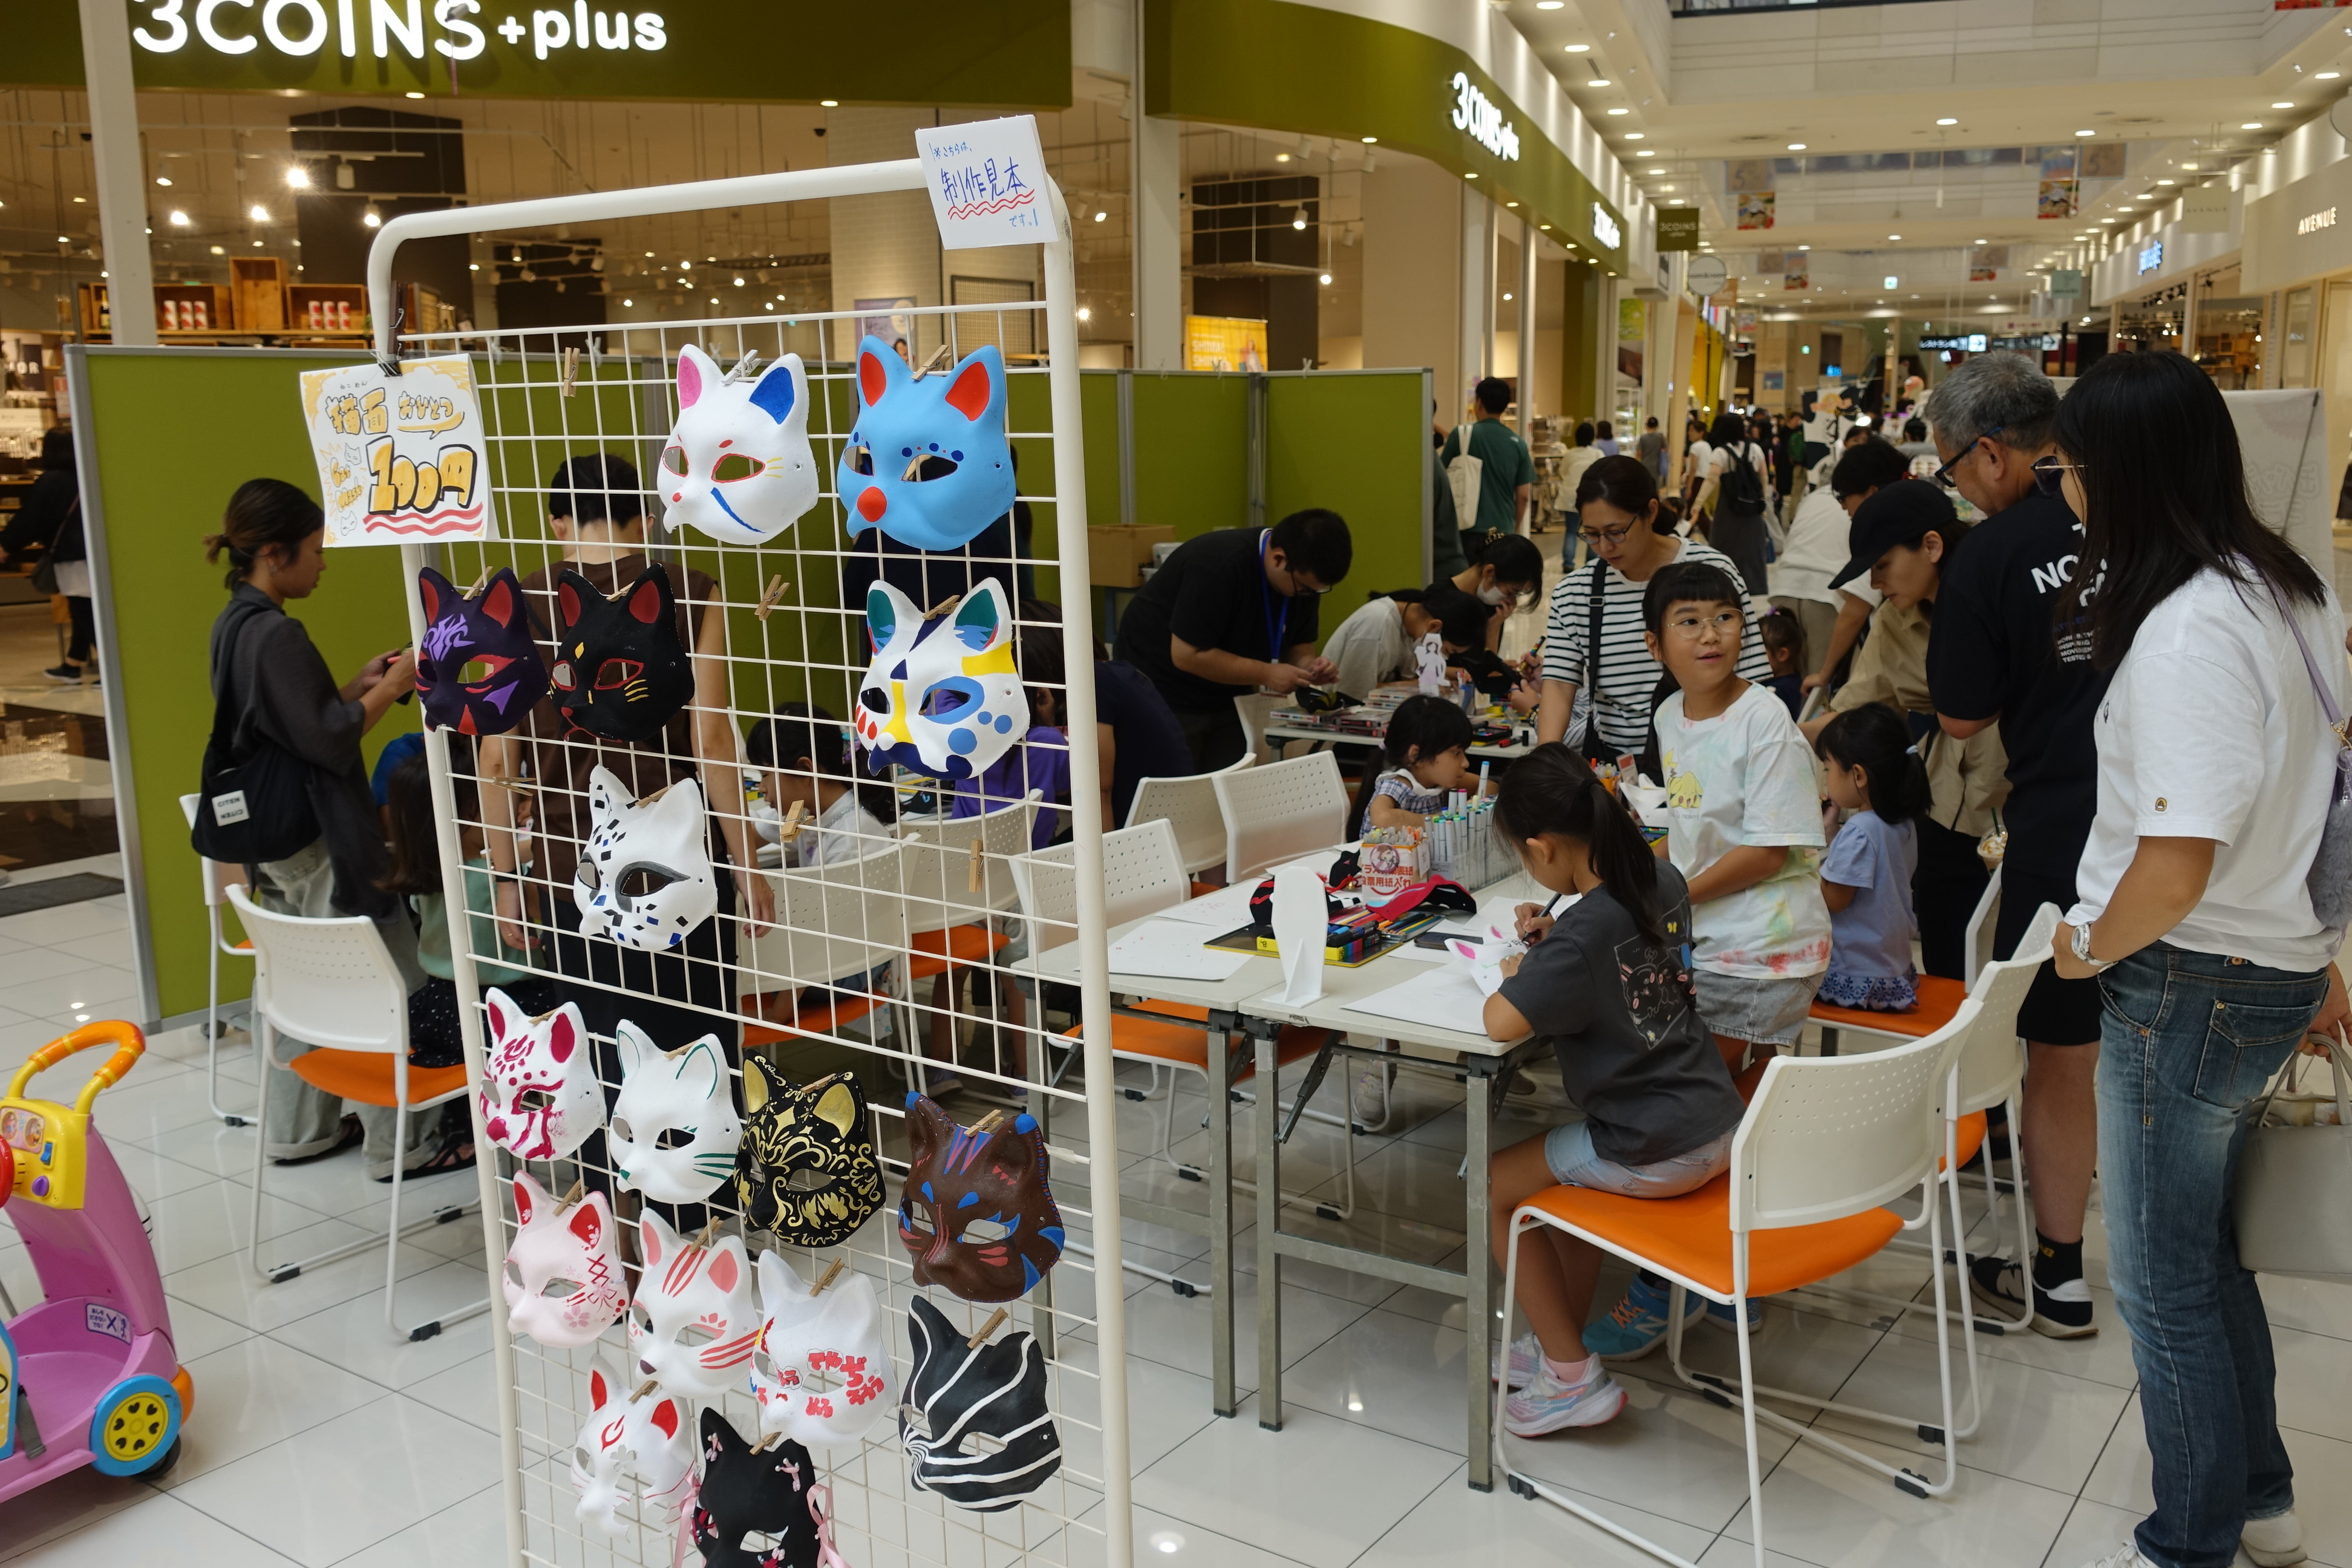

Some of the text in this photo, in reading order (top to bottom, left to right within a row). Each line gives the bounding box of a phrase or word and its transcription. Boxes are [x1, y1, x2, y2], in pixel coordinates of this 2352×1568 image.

[132, 0, 667, 60] 3COINS +plus
[1452, 71, 1502, 156] 3COINS
[941, 156, 1028, 206] 制作見本
[1659, 221, 1697, 232] 3COINS
[2297, 206, 2337, 236] AVENUE
[339, 380, 368, 389] ねこめん
[365, 434, 478, 515] 100円
